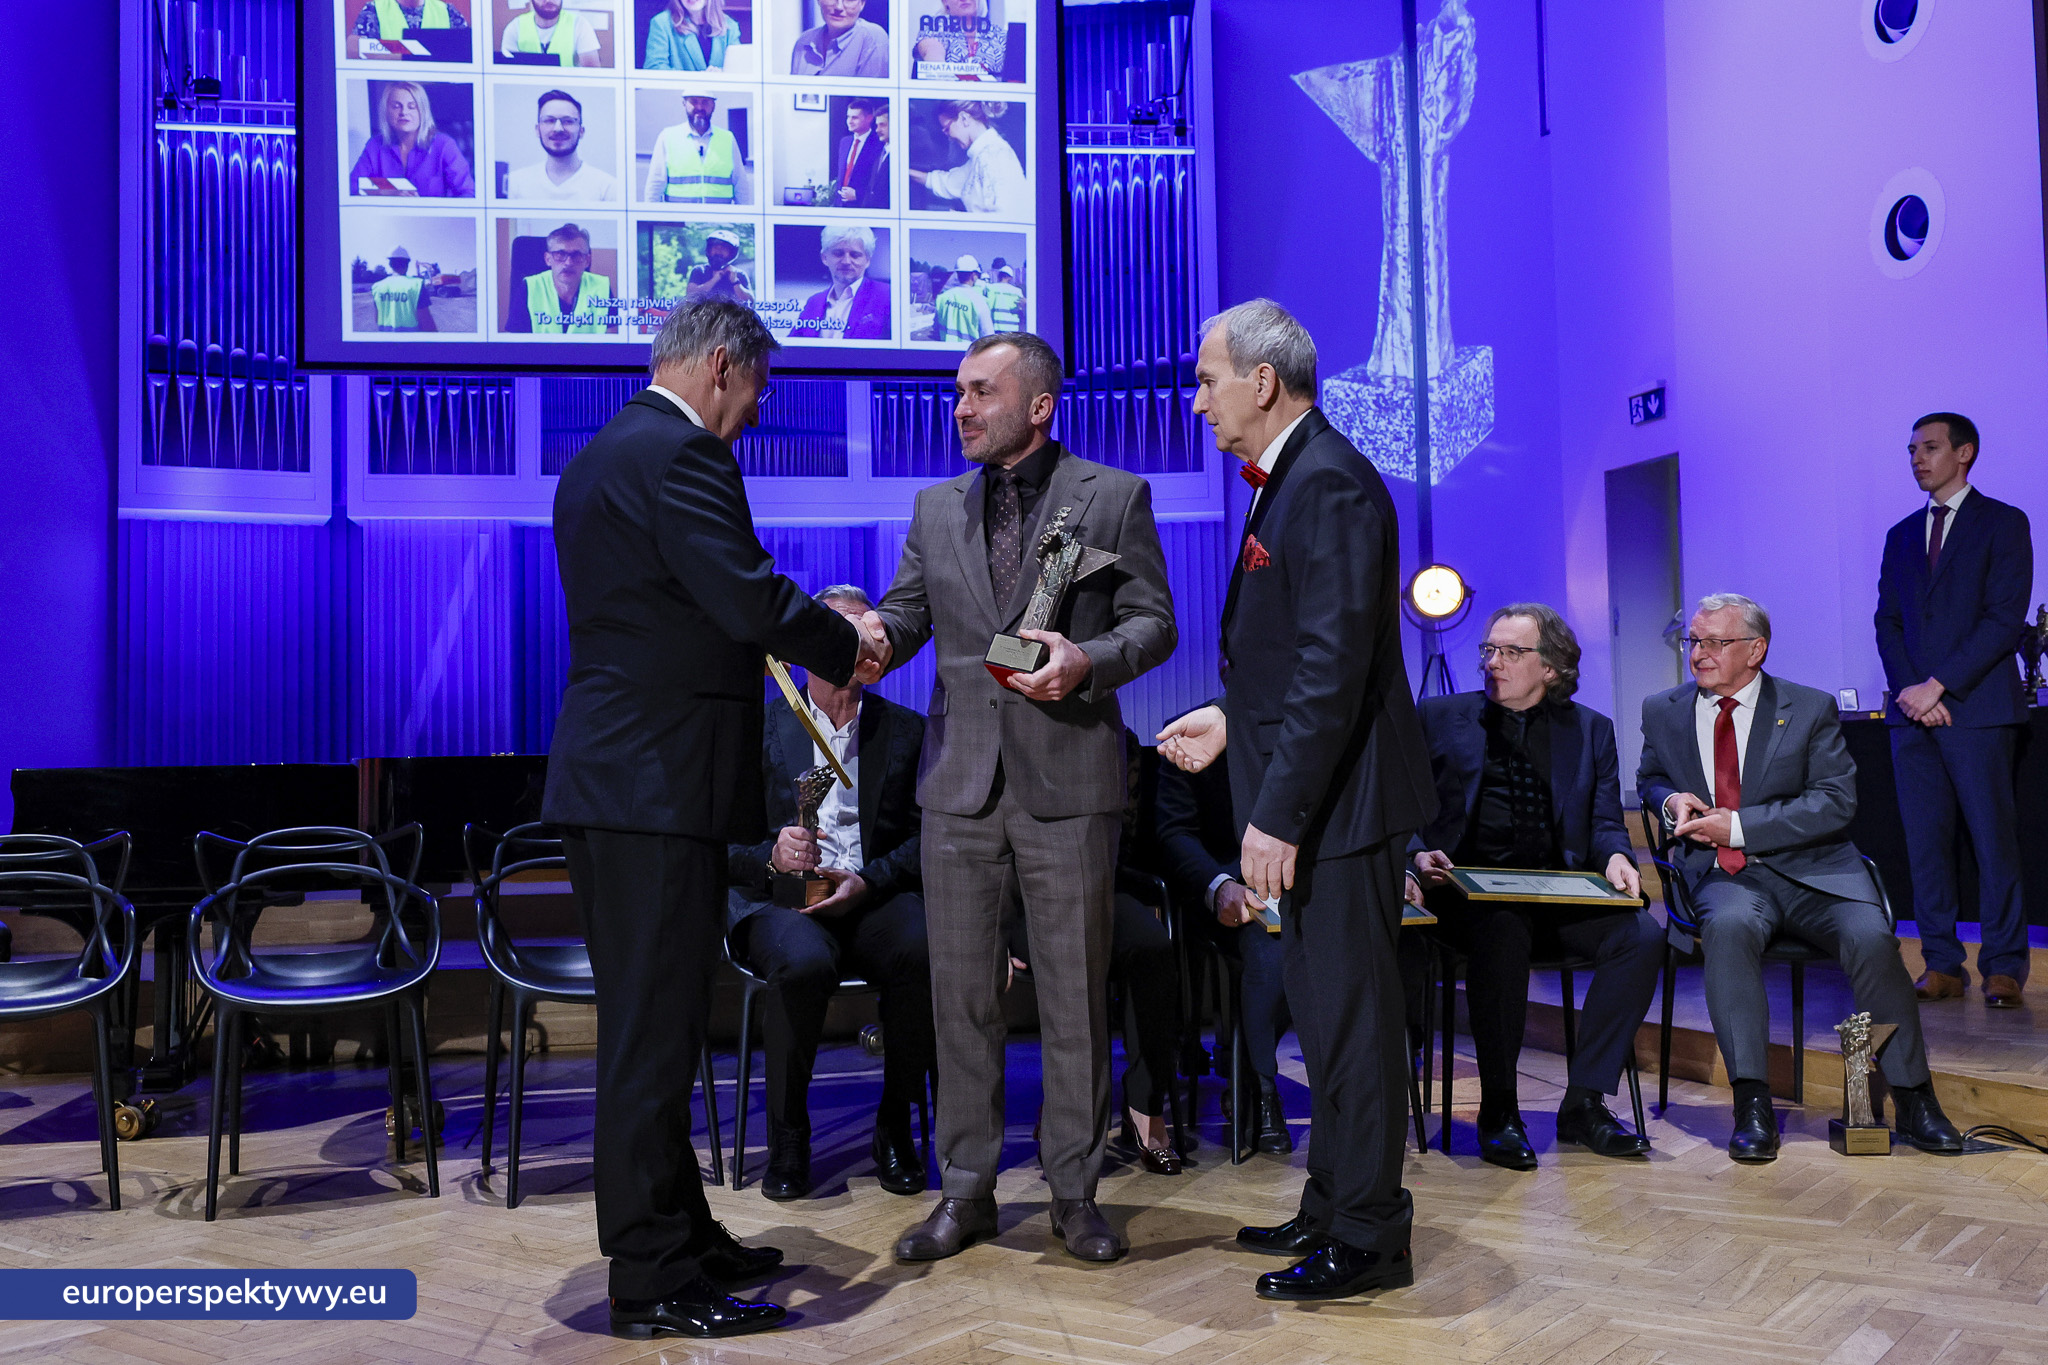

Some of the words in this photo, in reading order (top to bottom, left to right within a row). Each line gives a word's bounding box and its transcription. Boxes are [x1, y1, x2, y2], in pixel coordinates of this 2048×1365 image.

[920, 63, 951, 71] RENATA
[630, 296, 677, 310] najwięk
[755, 299, 803, 313] zespół.
[535, 312, 552, 325] To
[555, 312, 593, 327] dzięki
[597, 313, 622, 325] nim
[627, 312, 666, 325] realizu
[762, 316, 792, 330] ejsze
[795, 317, 851, 331] projekty.
